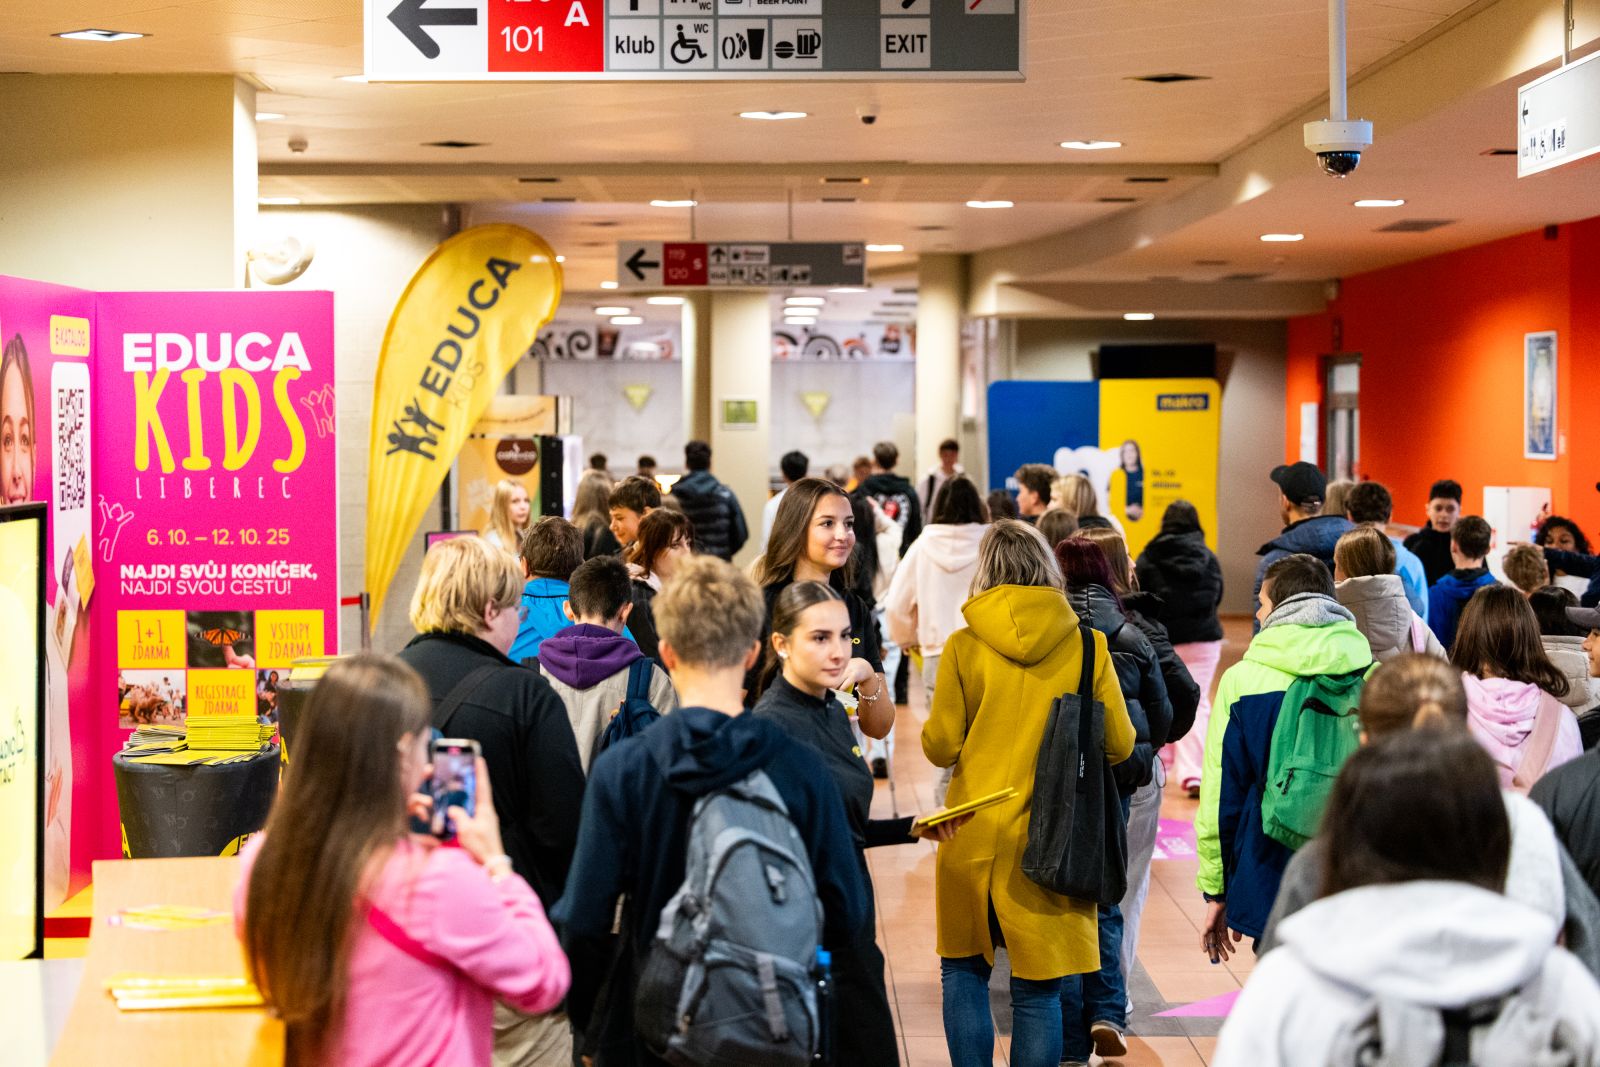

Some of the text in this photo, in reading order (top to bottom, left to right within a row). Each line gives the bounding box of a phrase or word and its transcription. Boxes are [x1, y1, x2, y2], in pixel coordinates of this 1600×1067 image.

[564, 1, 590, 26] A
[699, 2, 712, 10] WC
[694, 23, 709, 33] WC
[500, 26, 543, 52] 101
[615, 36, 655, 54] klub
[885, 34, 927, 53] EXIT
[419, 257, 522, 397] EDUCA
[122, 331, 312, 372] EDUCA
[133, 366, 307, 474] KIDS
[136, 476, 292, 499] LIBEREC
[146, 528, 163, 545] 6.
[167, 528, 190, 545] 10.
[211, 528, 234, 545] 12.
[239, 528, 261, 545] 10.
[266, 528, 290, 545] 25
[120, 560, 318, 581] NAJDI SVŮJ KONÍČEK,
[121, 579, 292, 595] NAJDI SVOU CESTU!
[270, 622, 310, 641] VSTUPY
[132, 644, 170, 660] ZDARMA
[268, 642, 312, 659] ZDARMA
[195, 685, 247, 700] REGISTRACE
[203, 700, 239, 715] ZDARMA
